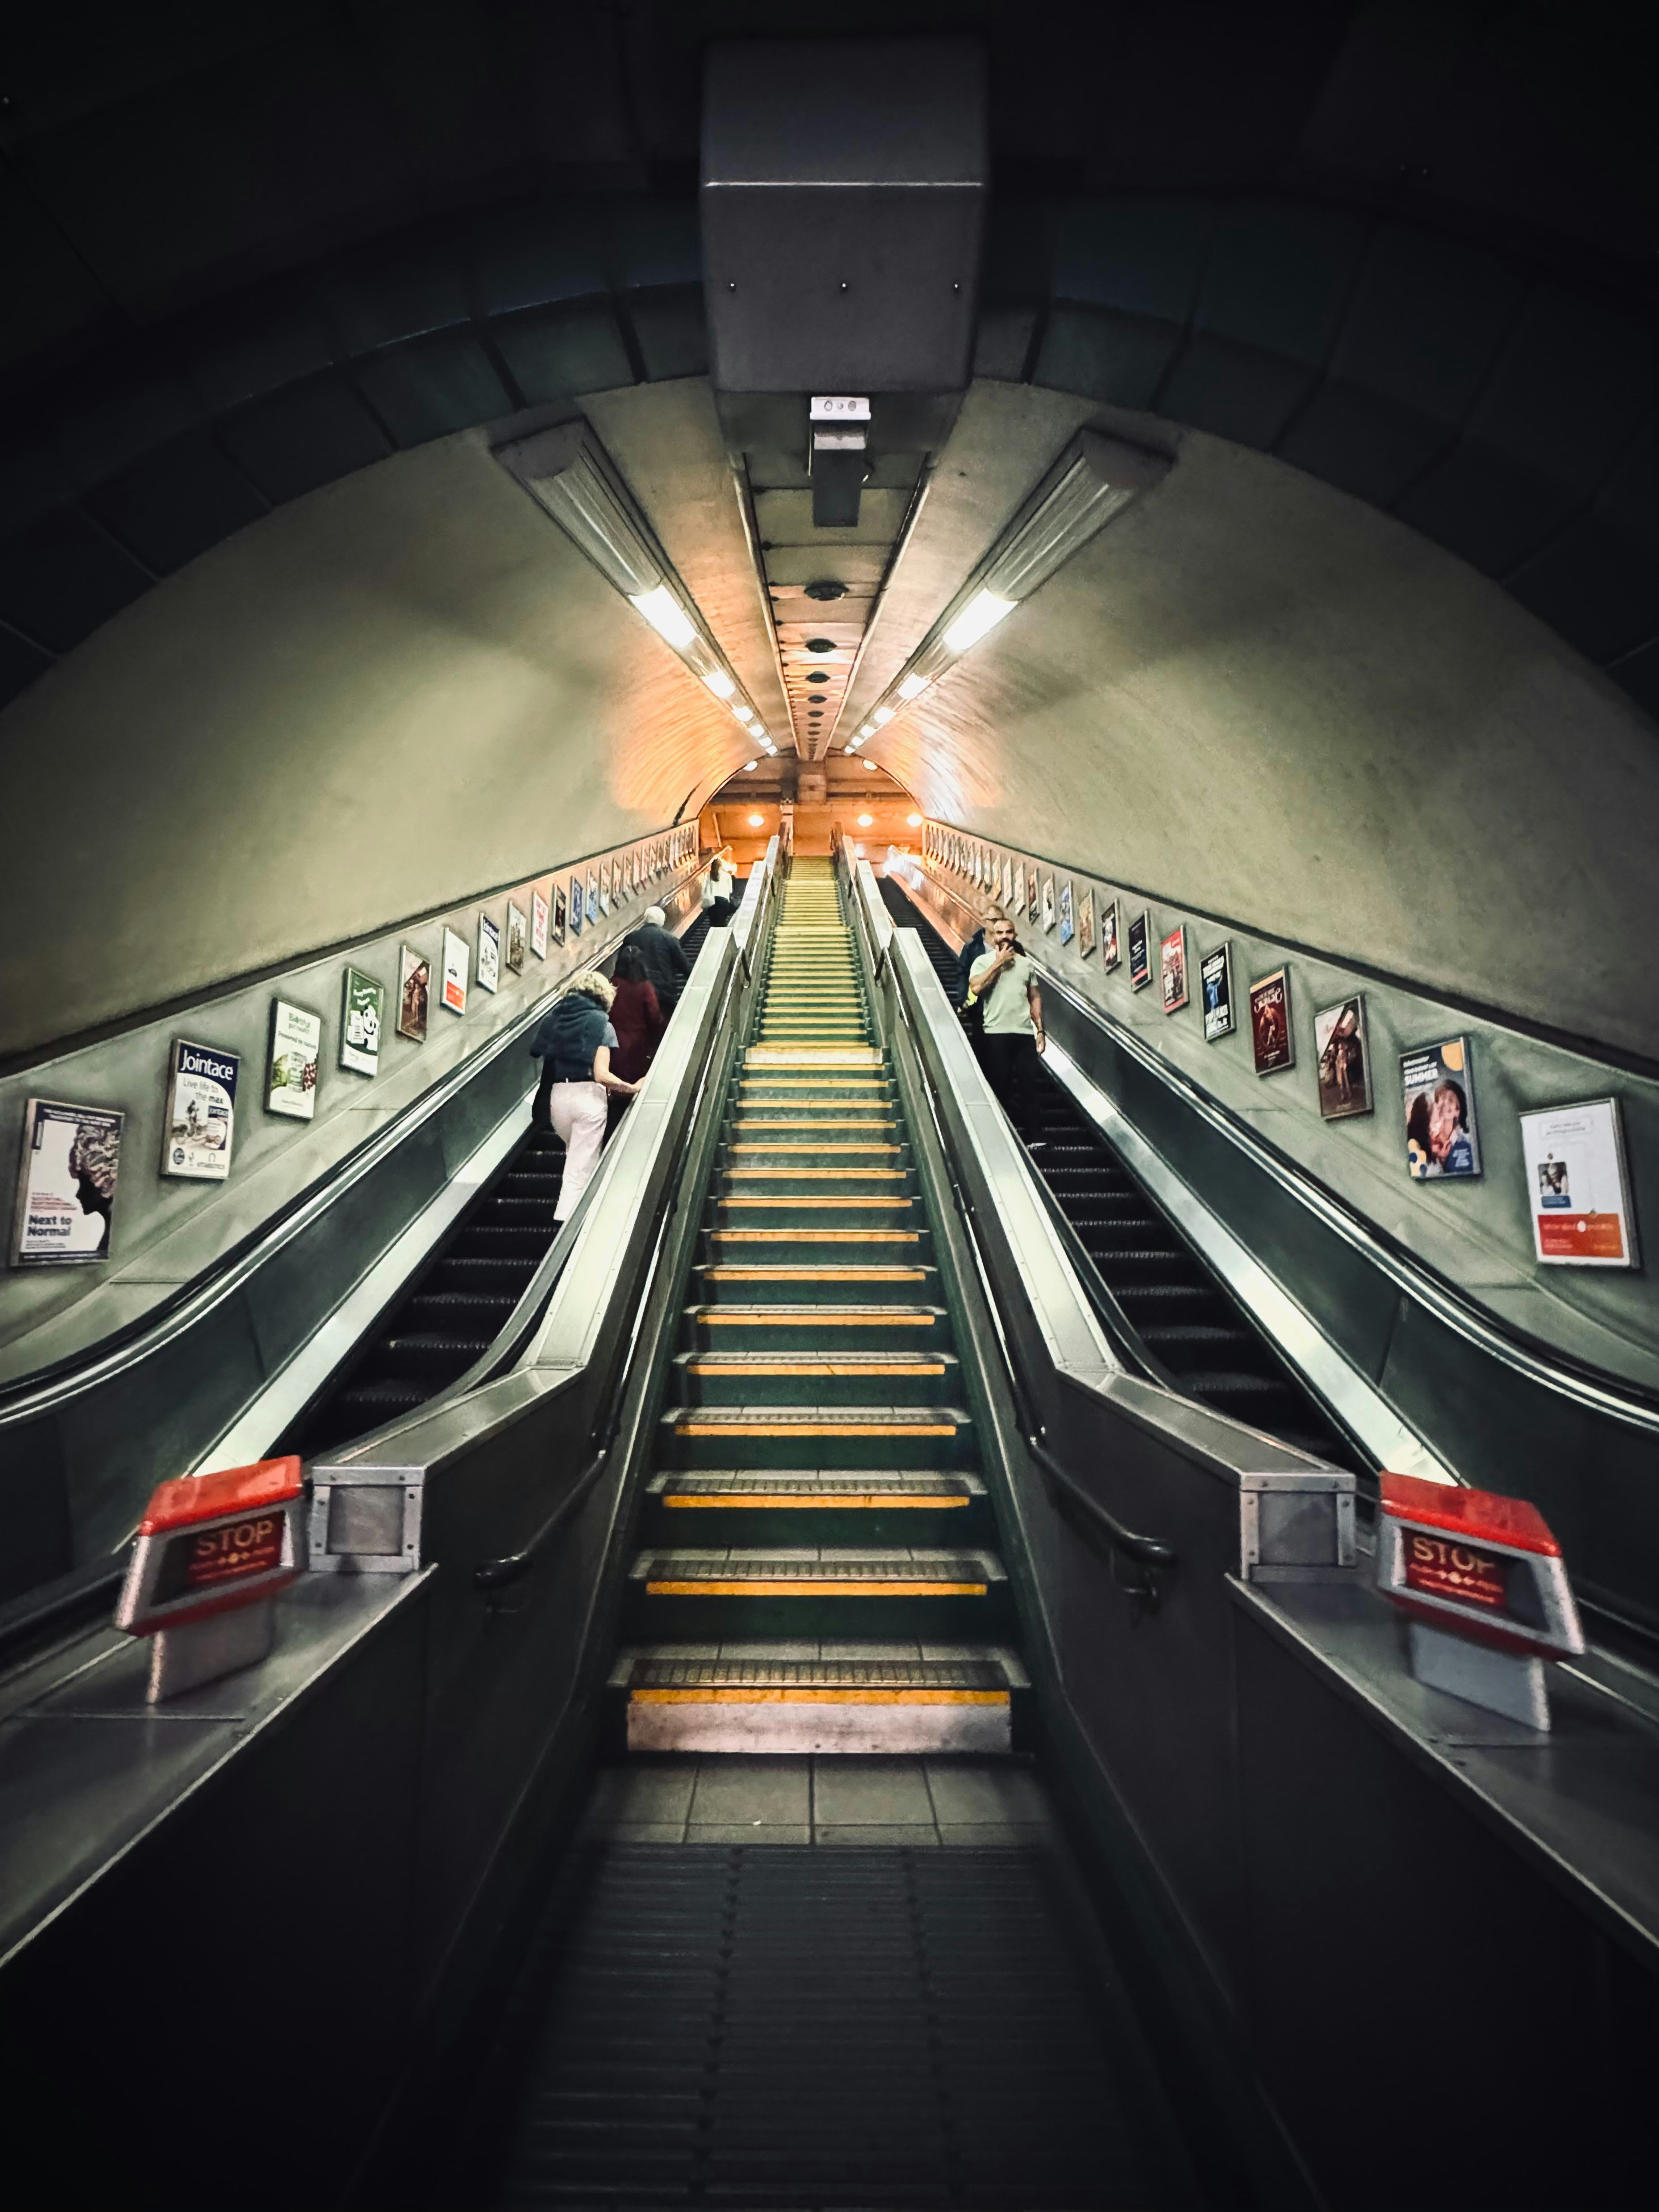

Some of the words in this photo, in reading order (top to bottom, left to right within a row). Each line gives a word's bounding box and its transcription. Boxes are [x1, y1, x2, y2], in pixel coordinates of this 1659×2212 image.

[180, 1049, 233, 1080] Jointace
[183, 1077, 198, 1089] Live
[1404, 1068, 1438, 1086] SUMMER
[208, 1095, 224, 1104] max
[29, 1215, 57, 1225] Next
[60, 1216, 72, 1225] to
[27, 1226, 72, 1236] Normal
[195, 1519, 274, 1556] STOP
